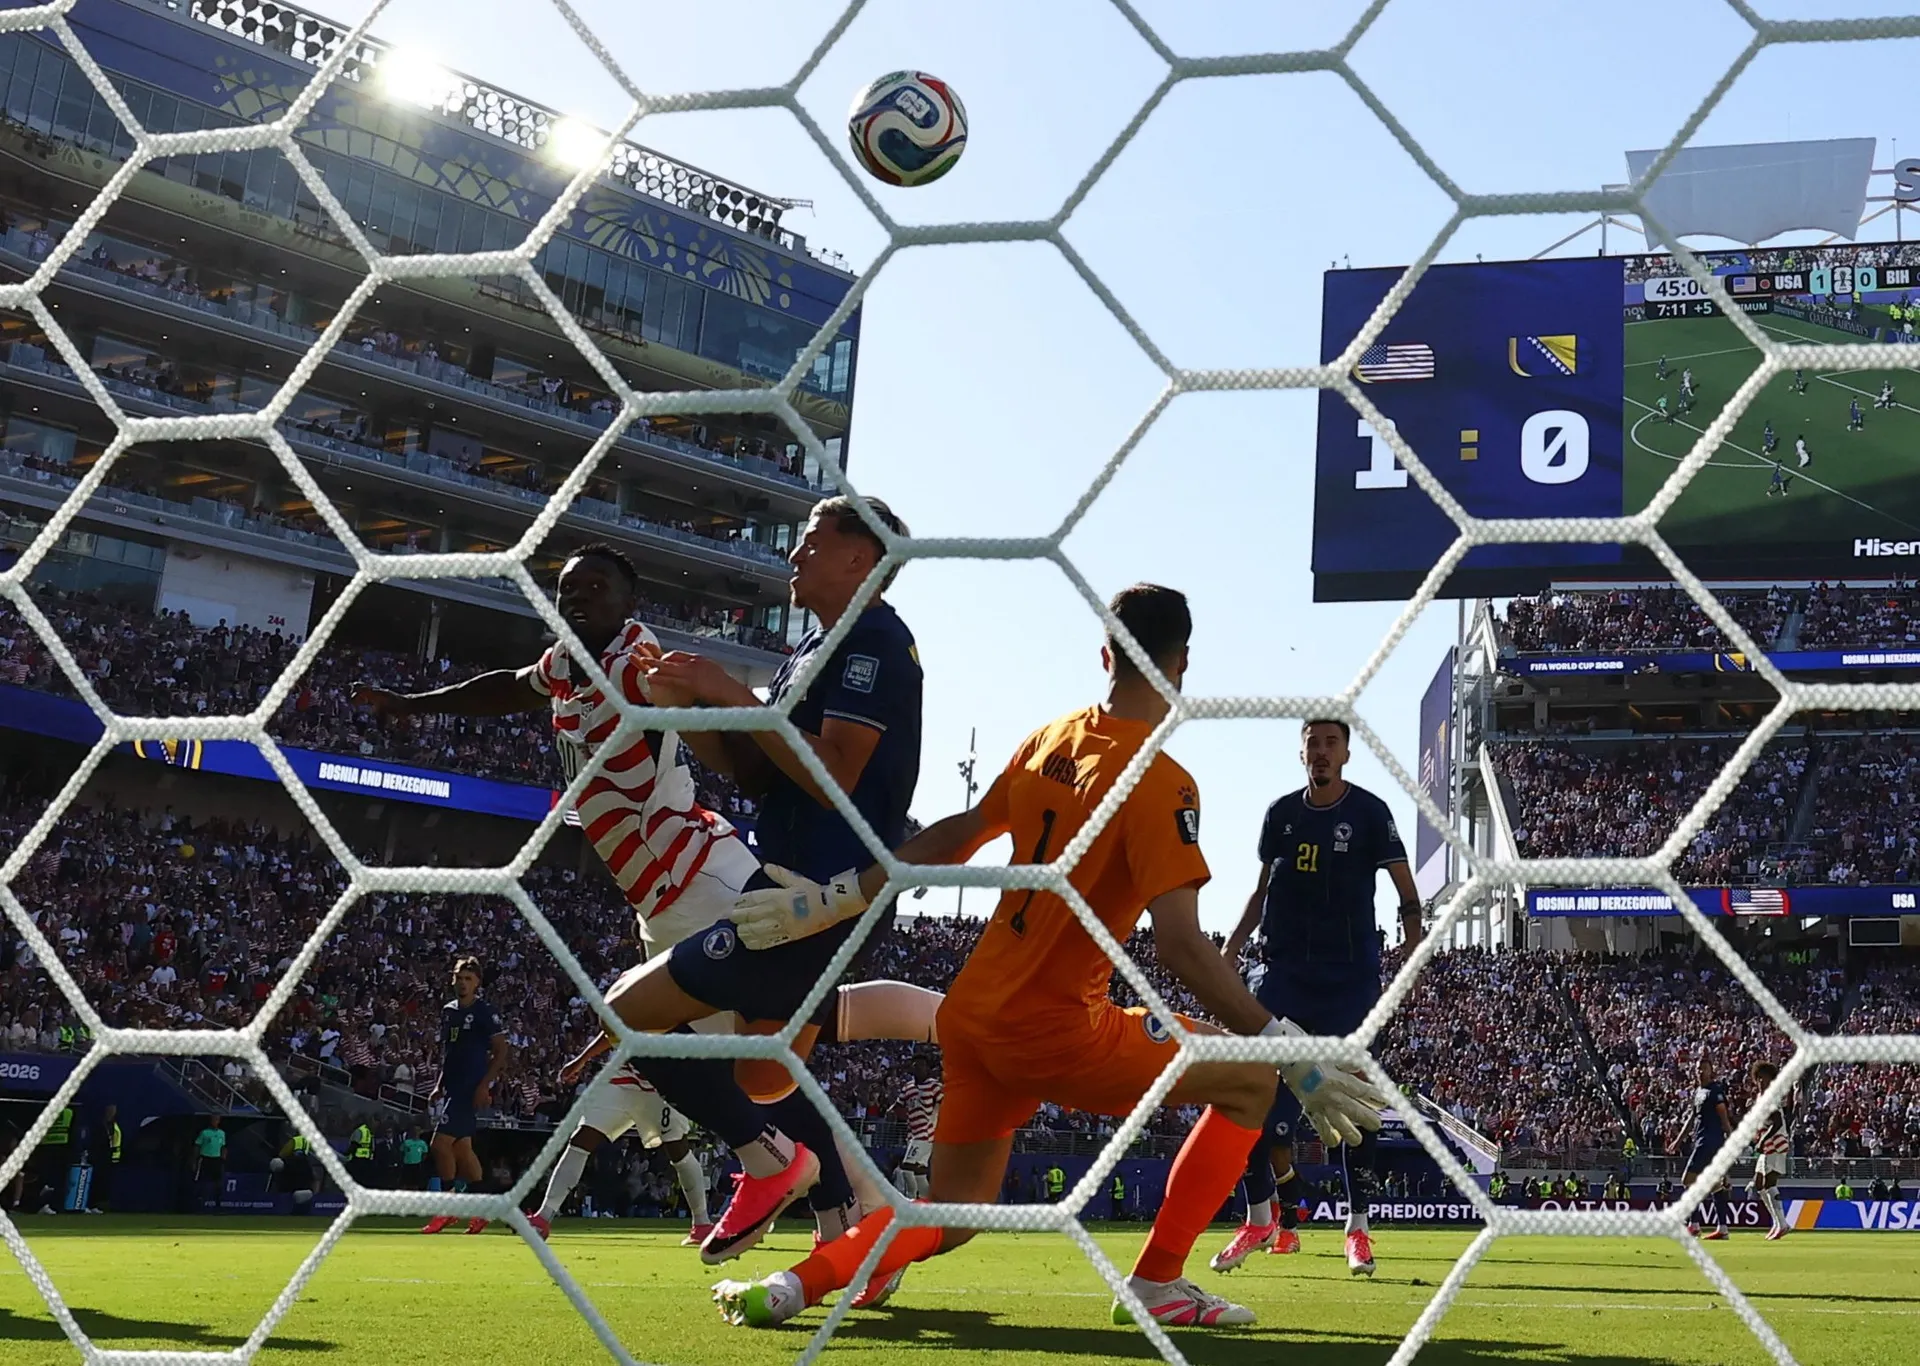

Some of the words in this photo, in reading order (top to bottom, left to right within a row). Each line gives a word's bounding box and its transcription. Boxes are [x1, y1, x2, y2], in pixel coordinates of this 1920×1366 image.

[1774, 274, 1803, 290] USA
[1885, 269, 1910, 285] BIH
[1657, 303, 1687, 317] 7:11
[1694, 301, 1713, 315] +5
[1355, 418, 1408, 490] 1
[1521, 409, 1590, 485] 0
[267, 614, 285, 627] 244
[1530, 663, 1548, 671] FIFA
[1548, 662, 1577, 671] WORLD
[1578, 662, 1594, 670] CUP
[1595, 660, 1624, 670] 2026
[1869, 654, 1885, 664] AND
[318, 762, 360, 784] BOSNIA
[359, 769, 383, 788] AND
[382, 772, 450, 798] HERZEGOVINA
[1297, 843, 1318, 872] 21
[1536, 897, 1576, 911] BOSNIA
[1577, 897, 1600, 911] AND
[1601, 896, 1673, 910] HERZEGOVINA
[1892, 894, 1916, 908] USA
[0, 1063, 40, 1080] 2026
[661, 1106, 671, 1128] 8
